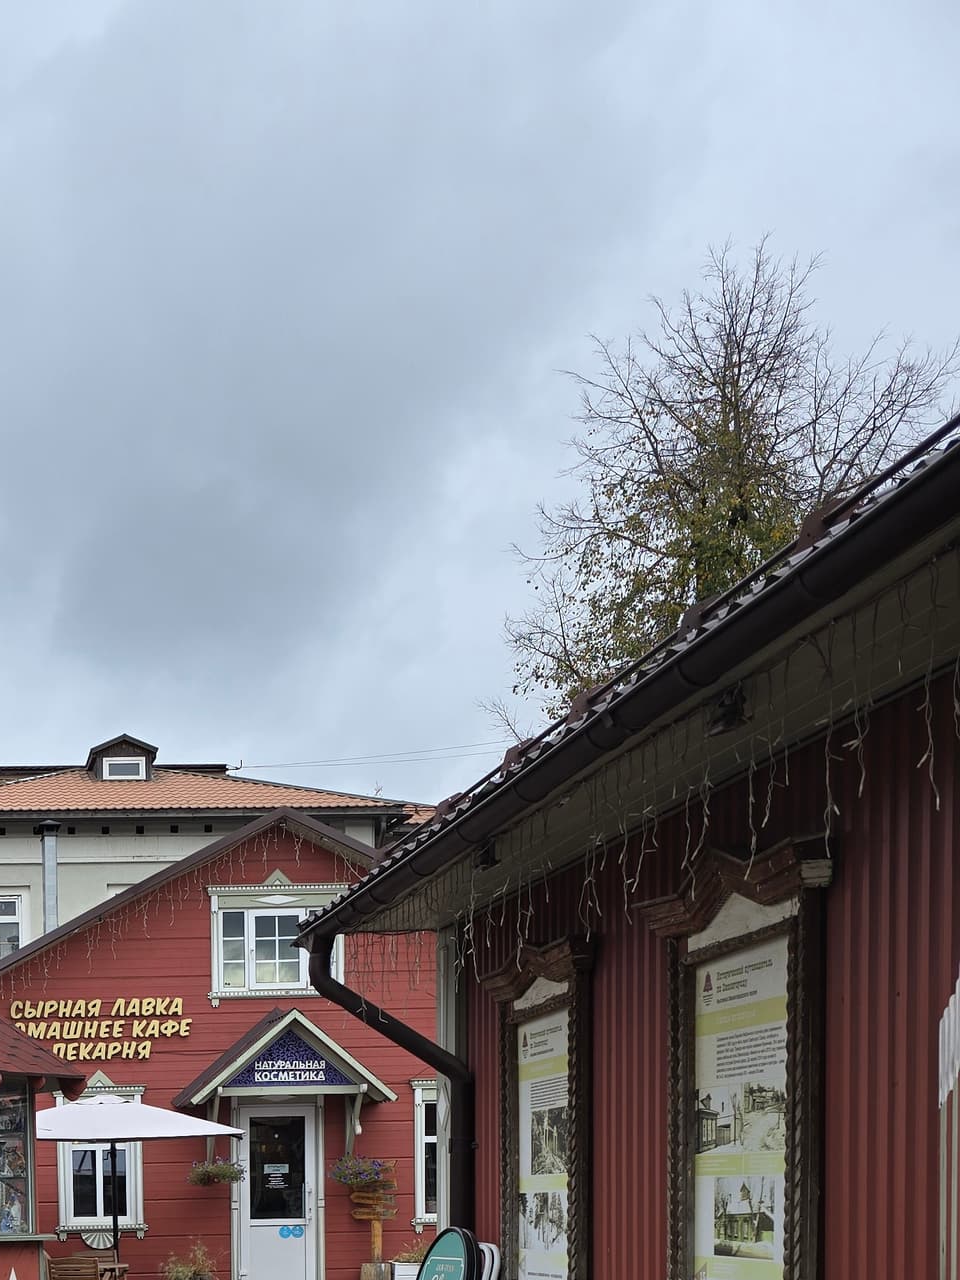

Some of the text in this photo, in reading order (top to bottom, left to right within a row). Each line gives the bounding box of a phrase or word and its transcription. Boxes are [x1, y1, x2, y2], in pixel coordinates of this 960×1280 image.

[10, 996, 183, 1019] СЫРНАЯ ЛАВКА
[15, 1018, 193, 1040] МАШНЕЕ КАФЕ
[52, 1040, 152, 1061] ПЕКАРНЯ
[254, 1060, 326, 1070] НАТУРАЛЬНАЯ
[254, 1071, 326, 1082] КОСМЕТИКА
